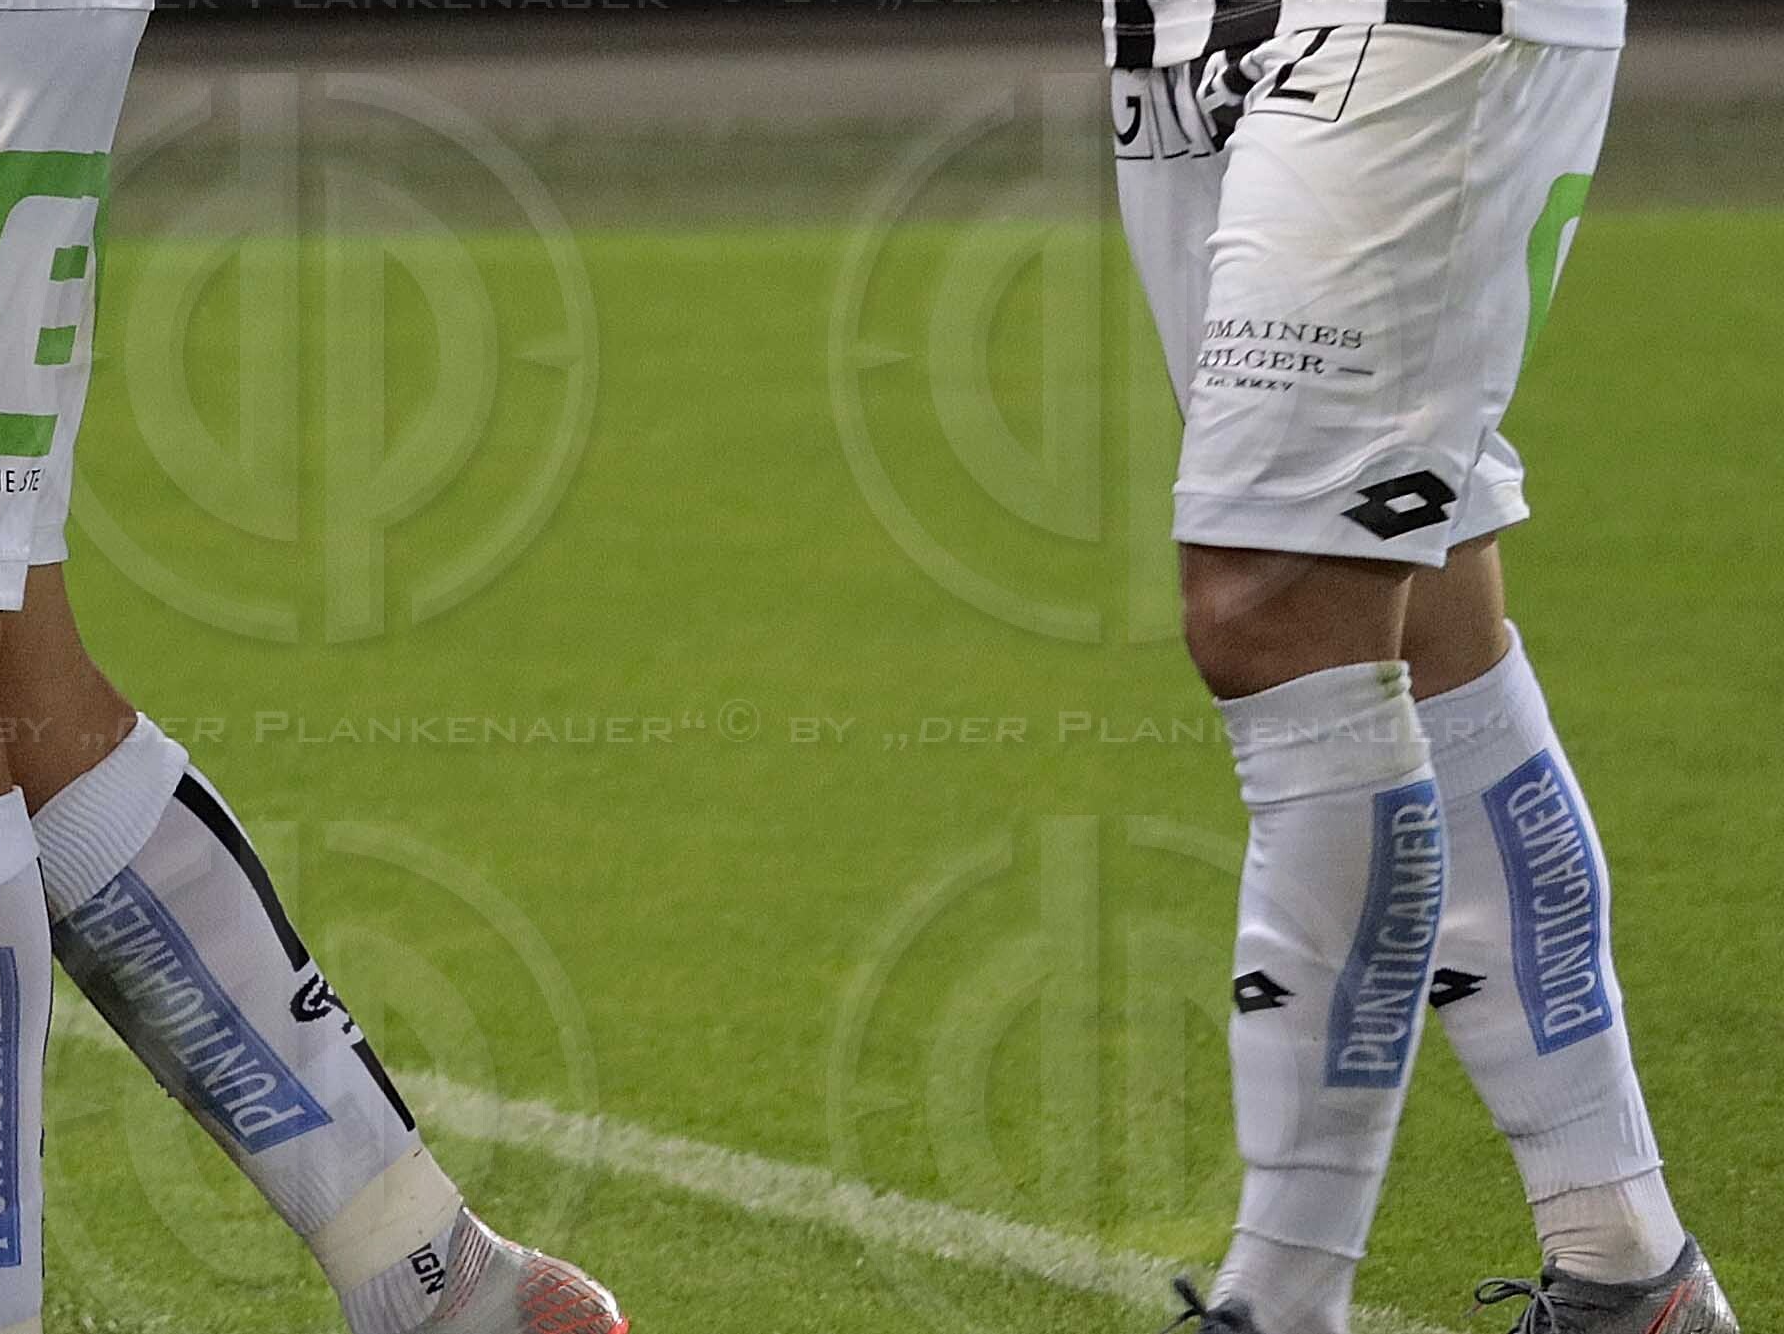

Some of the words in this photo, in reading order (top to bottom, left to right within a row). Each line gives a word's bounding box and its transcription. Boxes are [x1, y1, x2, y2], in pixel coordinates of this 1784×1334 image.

[1207, 318, 1363, 350] OMAINES
[72, 885, 308, 1137] PUNTIGAMER
[1338, 803, 1442, 1073] PUNTIGAMER
[1506, 770, 1604, 1036] PUNTIGAMER
